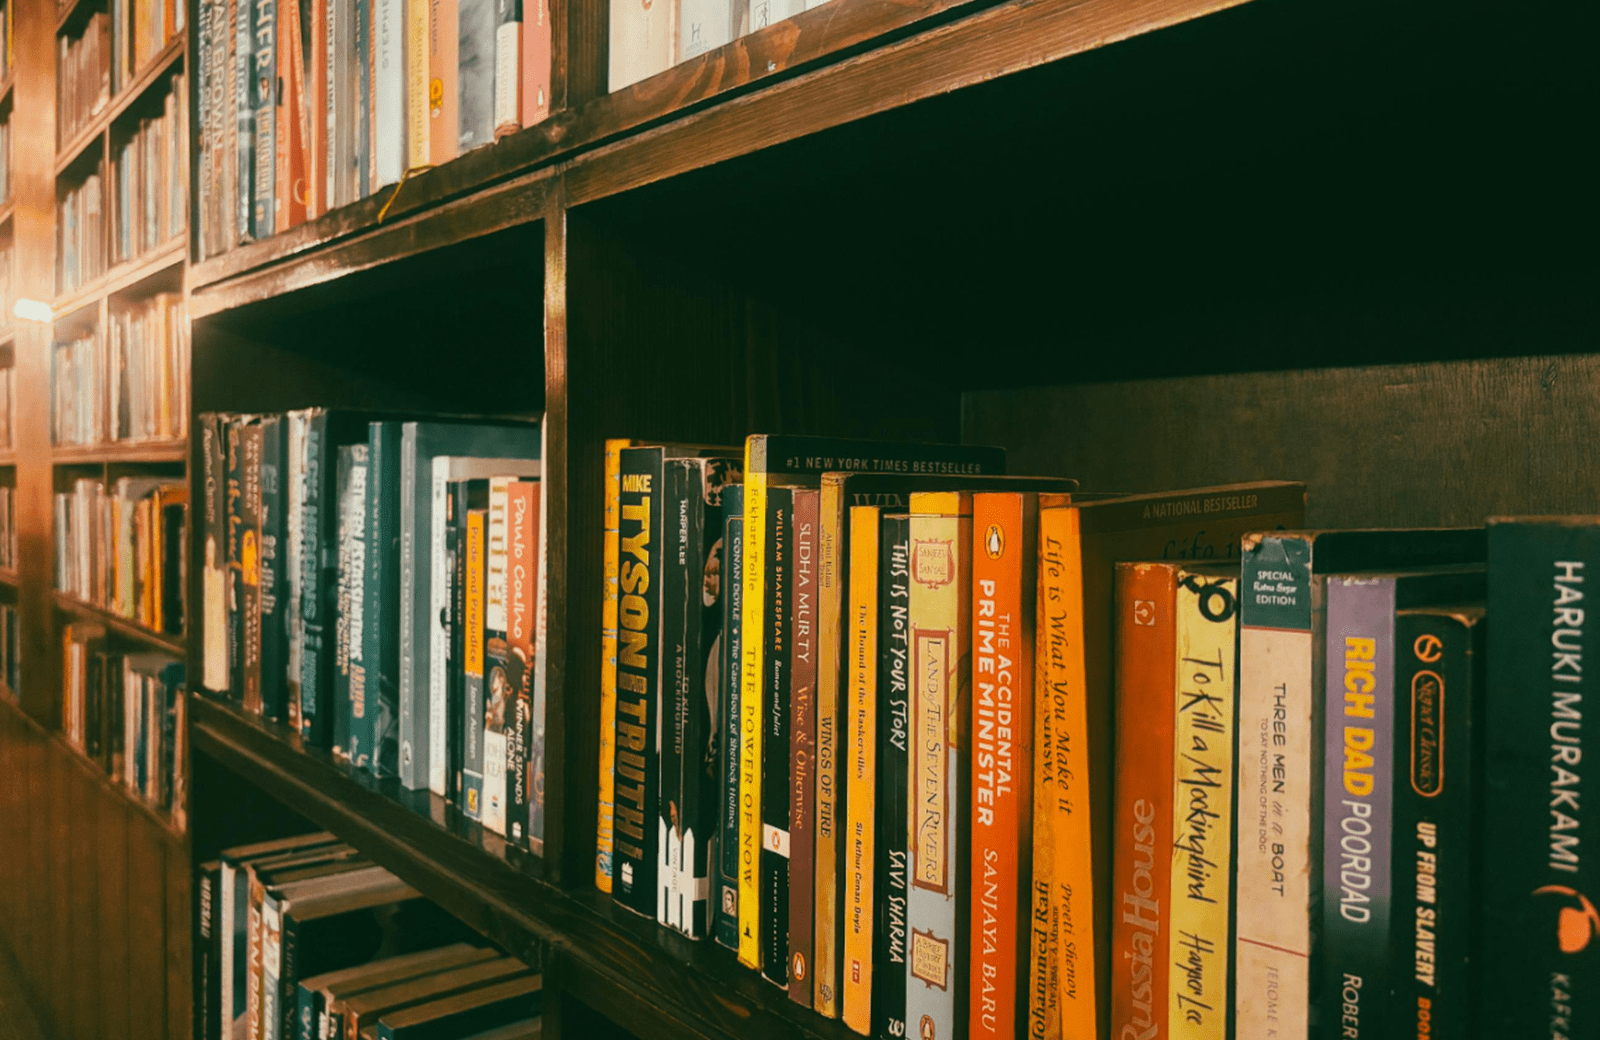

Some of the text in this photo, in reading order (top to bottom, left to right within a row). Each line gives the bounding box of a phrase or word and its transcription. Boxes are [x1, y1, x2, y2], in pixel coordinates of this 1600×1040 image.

[213, 47, 226, 150] BROWN
[622, 474, 652, 493] MIKE
[786, 457, 982, 474] #1 NEW YORK TIMES BESTSELLER
[1143, 495, 1258, 519] A NATIONAL BESTSELLER
[304, 505, 318, 619] HIGGINS
[470, 566, 478, 594] and
[513, 495, 527, 639] Paulo Coelho
[619, 496, 651, 669] TYSON
[678, 499, 689, 566] HARPER LEE
[749, 488, 760, 592] Eckhart Tolle
[825, 561, 833, 588] Kalam
[1257, 570, 1294, 581] SPECIAL
[470, 598, 478, 664] Prejudice
[772, 508, 784, 736] WILLIAM SHAKESPEARE Romeo and Juliet
[797, 523, 812, 664] SUDHA MURTY
[889, 541, 909, 751] THIS IS NOT YOUR STORY
[1255, 595, 1296, 606] EDITION
[674, 644, 683, 755] A MOCKINGBIRD
[728, 537, 742, 829] CONAN DOYLE The Case-Book of Sherlock Holmes
[856, 605, 867, 780] The Hound of the Baskervilles
[977, 579, 995, 826] PRIME MINISTER
[997, 613, 1012, 797] THE ACCIDENTAL
[1043, 535, 1075, 816] Life is What You Make it
[1260, 717, 1269, 731] TO
[1343, 636, 1376, 796] RICH DAD
[1549, 561, 1585, 873] HARUKI MURAKAMI
[506, 726, 516, 772] ALONE
[514, 698, 525, 804] WINNER STANDS
[743, 647, 756, 888] THE POWER OF NOW
[794, 686, 808, 830] Wise & Otherwise
[820, 716, 833, 839] WINGS OF FIRE
[918, 639, 942, 882] LAND THE SEVEN RIVERS
[1173, 647, 1226, 904] To Kill a Mockingbird
[1259, 749, 1269, 795] NOTHING
[1260, 731, 1269, 747] SAY
[1271, 682, 1288, 897] THREE MEN in a BOAT
[1259, 795, 1268, 809] OF
[1259, 809, 1268, 828] THE
[853, 821, 863, 934] Sir Arthur Conan Doyle
[888, 849, 906, 964] SAVI SHARMA
[1033, 880, 1050, 925] Rafi
[1415, 821, 1437, 987] UP FROM SLAVERY
[251, 906, 261, 968] DAN
[980, 848, 998, 1034] SANJAYA BARU
[1060, 883, 1077, 1000] Preeti Shenoy
[1175, 929, 1215, 1026] Harper Lee
[1265, 965, 1279, 1021] JEROME
[1341, 973, 1363, 1040] ROBER
